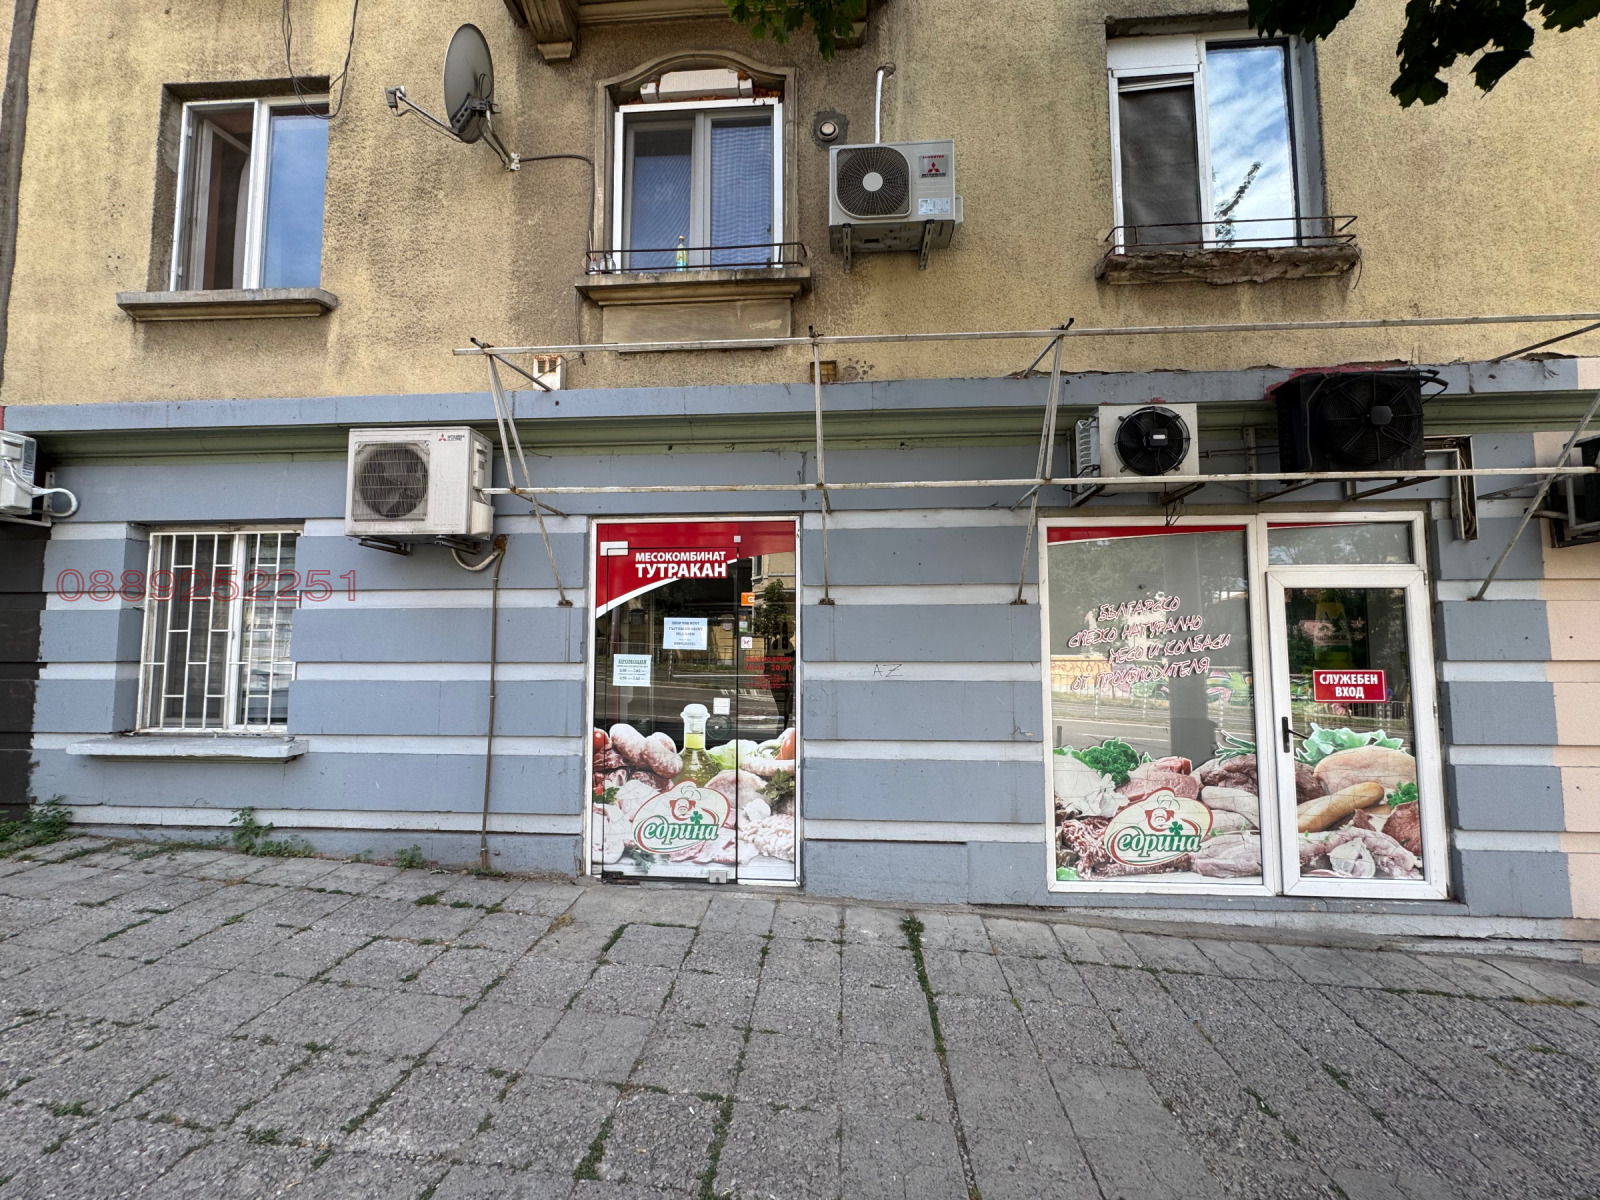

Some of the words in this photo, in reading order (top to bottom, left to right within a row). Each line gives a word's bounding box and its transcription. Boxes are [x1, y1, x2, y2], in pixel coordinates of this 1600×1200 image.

[635, 551, 727, 562] МЕСОКОМБИНАТ
[635, 562, 727, 578] ТУТРАКАН
[1098, 596, 1181, 621] БЪЛГАРСКО
[1121, 614, 1203, 640] НАТУРАЛНО
[1109, 646, 1144, 664] МЕСО
[1148, 643, 1160, 658] И
[1164, 633, 1232, 657] КОЛБАСИ
[1072, 674, 1091, 692] ОТ
[1095, 656, 1210, 690] ПРОИЗВОДИТЕЛЯ
[1319, 673, 1379, 685] СЛУЖЕБЕН
[1335, 686, 1365, 699] ВХОД
[643, 815, 720, 845] едрина
[1117, 826, 1202, 857] едрина
